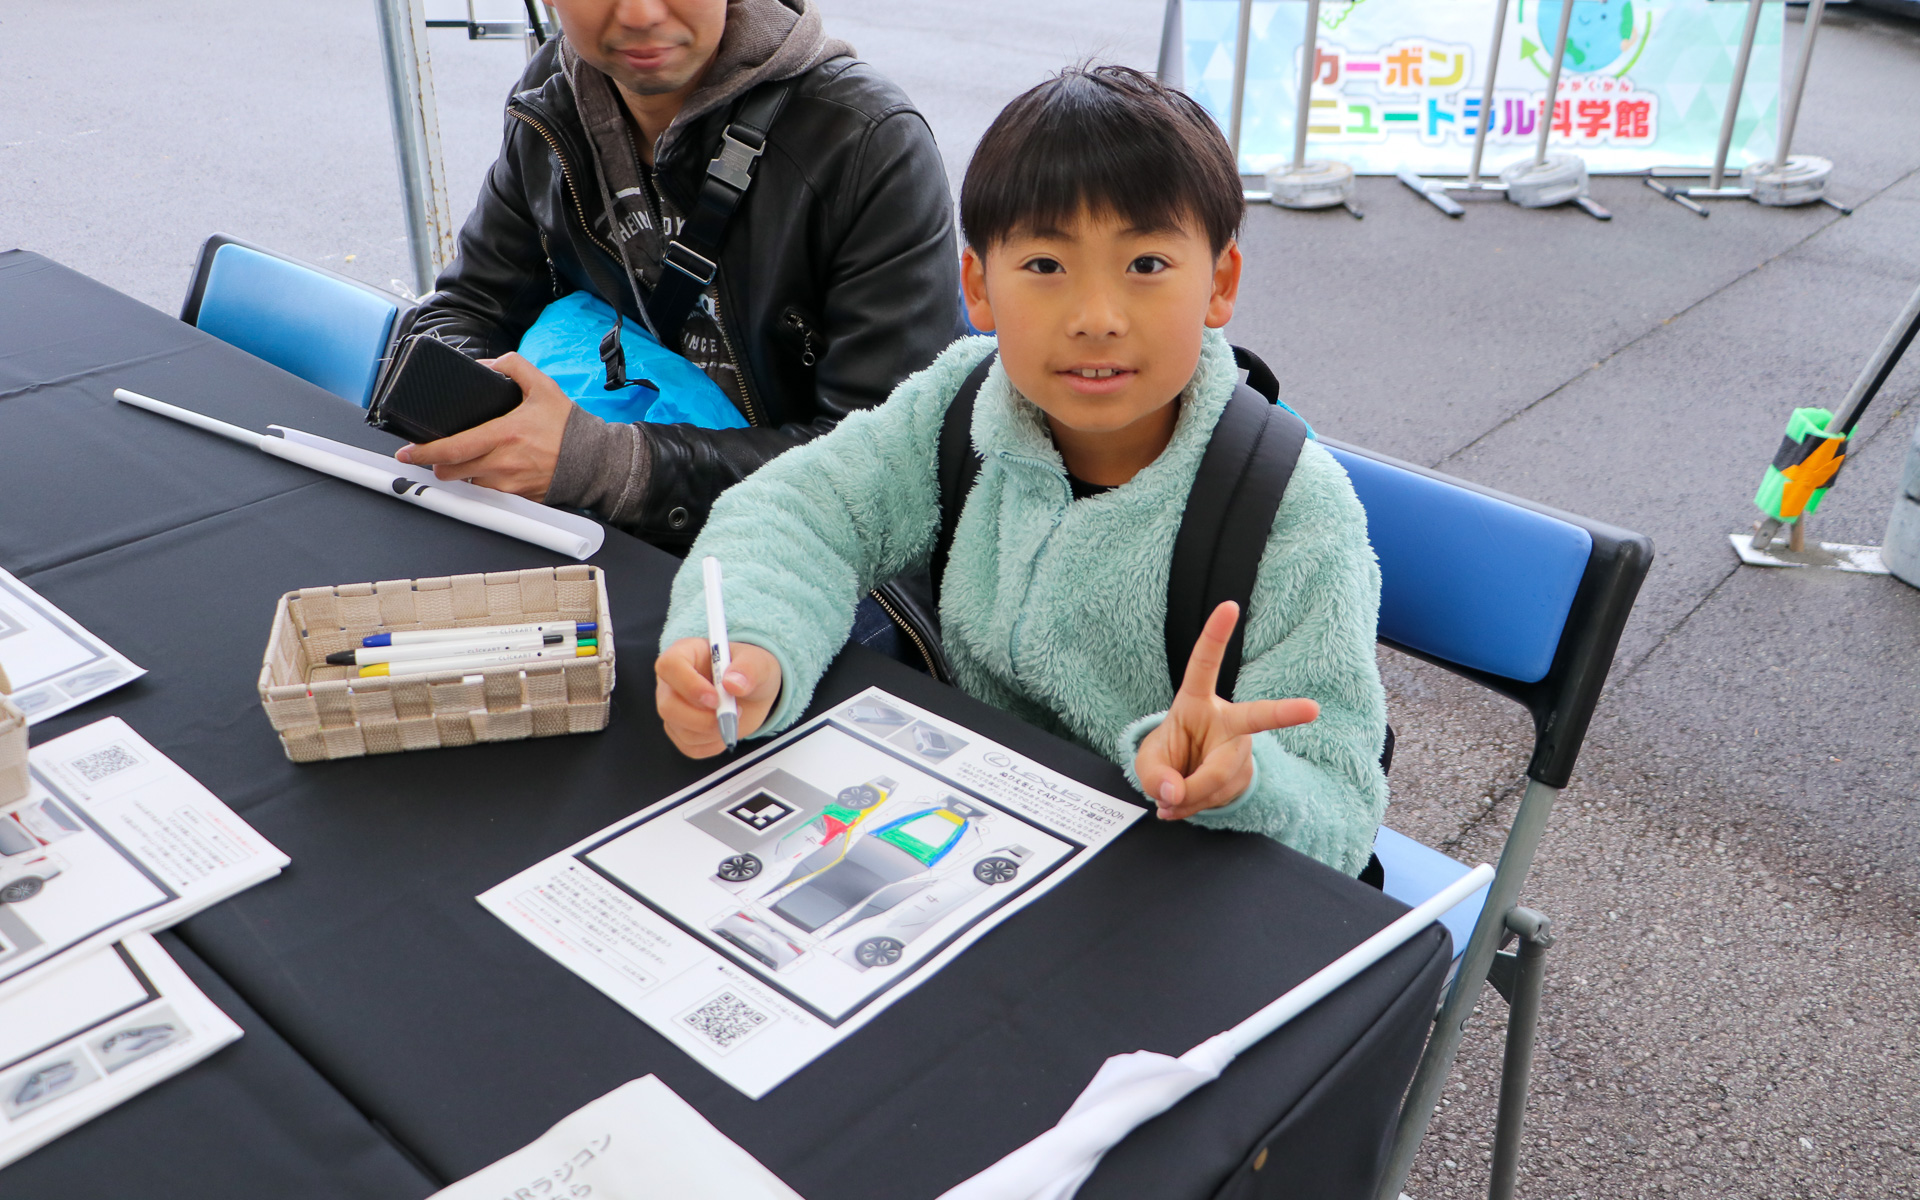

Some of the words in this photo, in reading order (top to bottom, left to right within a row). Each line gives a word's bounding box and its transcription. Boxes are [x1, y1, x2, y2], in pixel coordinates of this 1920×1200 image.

[1311, 48, 1464, 87] カーボン
[1307, 98, 1650, 138] ニュートラル科学館
[1007, 764, 1085, 802] LEXUS
[1082, 798, 1128, 821] LC500h
[503, 1133, 611, 1200] Rラジコン
